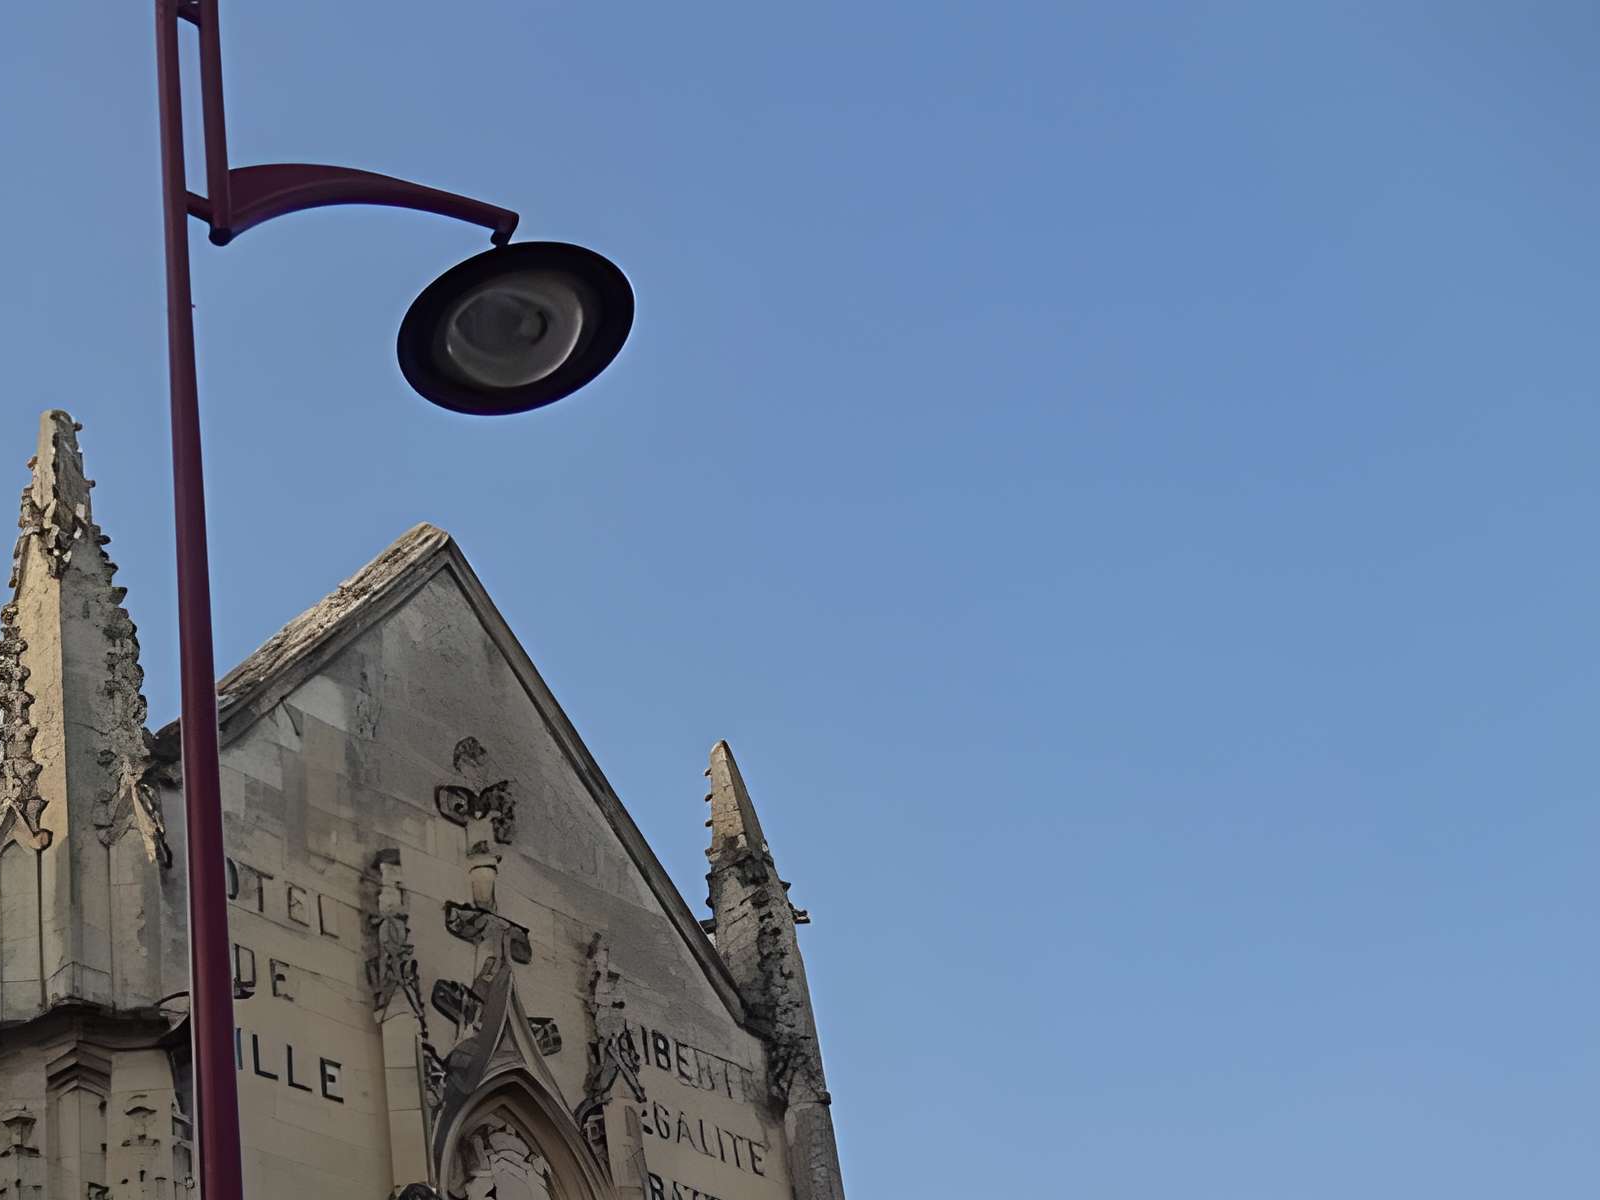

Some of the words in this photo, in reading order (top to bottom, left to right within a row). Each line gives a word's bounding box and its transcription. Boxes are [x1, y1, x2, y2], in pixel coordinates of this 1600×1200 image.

[234, 944, 294, 1001] DE
[236, 1027, 344, 1104] ILLE
[642, 1101, 769, 1177] GALITE
